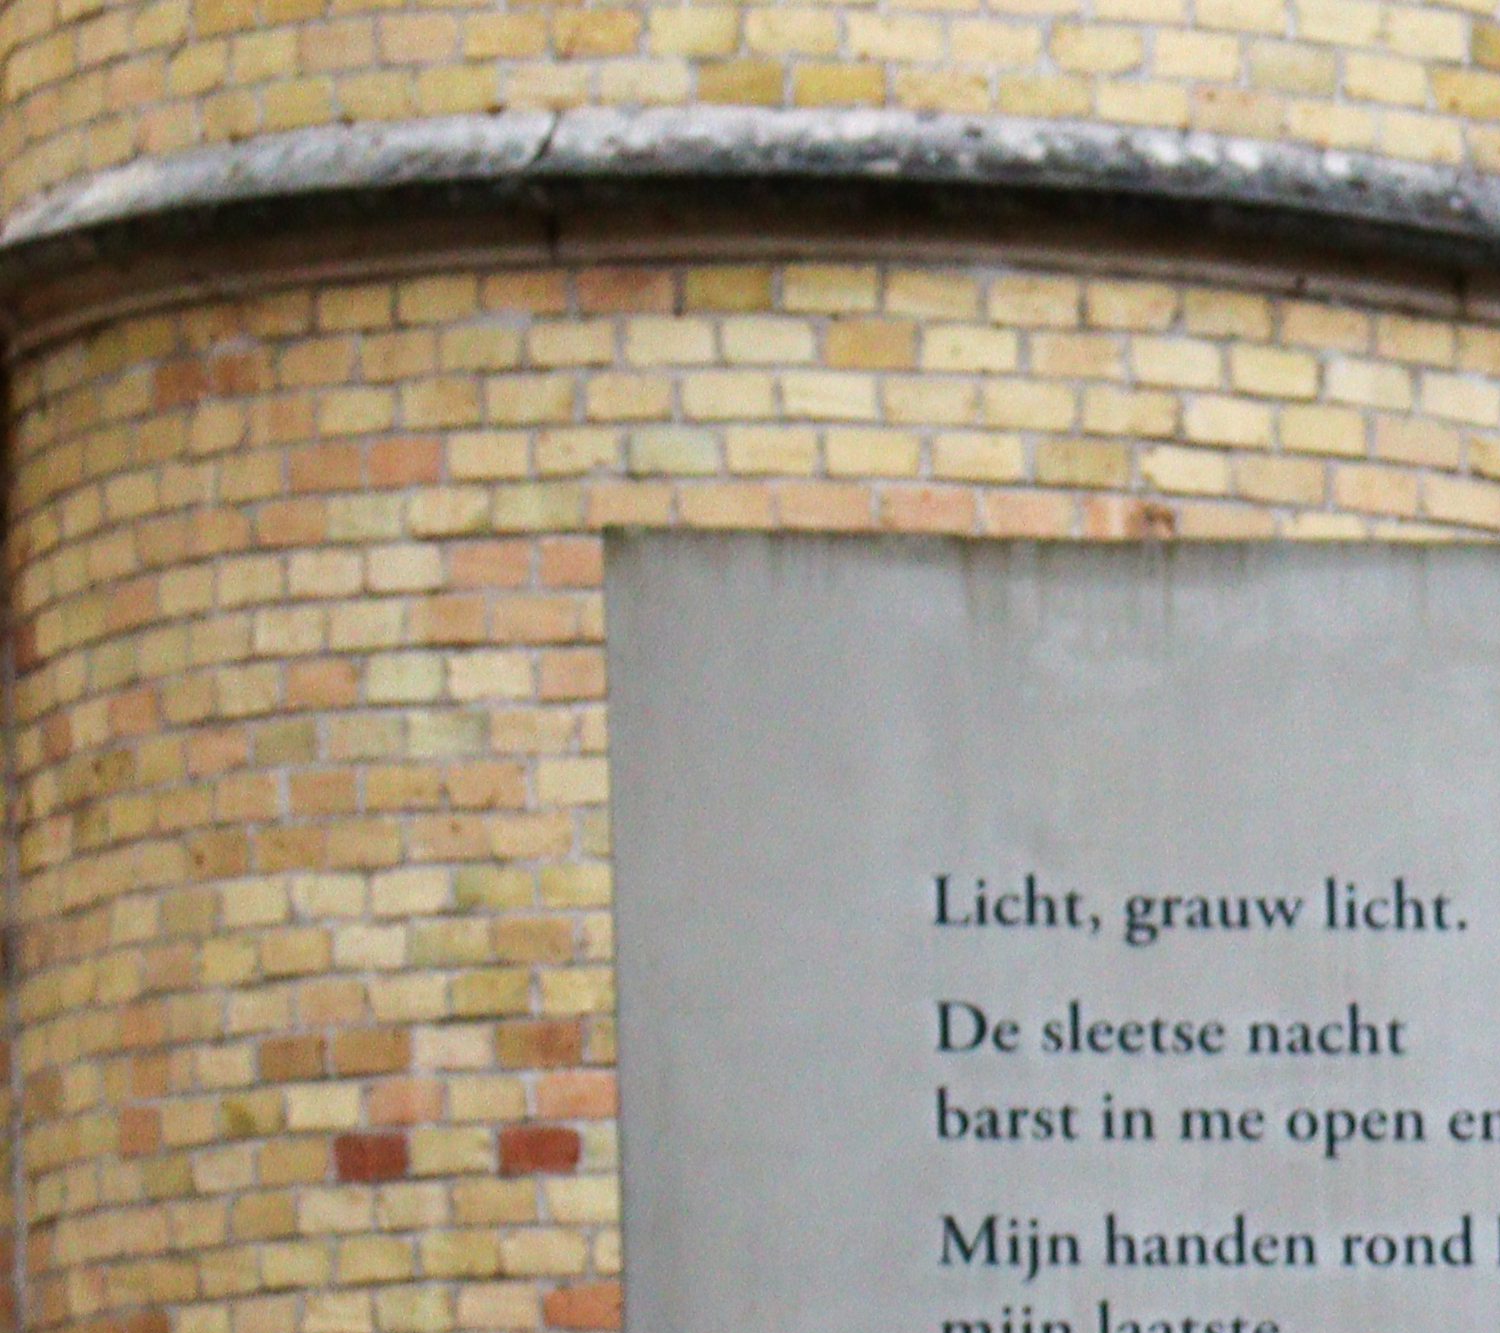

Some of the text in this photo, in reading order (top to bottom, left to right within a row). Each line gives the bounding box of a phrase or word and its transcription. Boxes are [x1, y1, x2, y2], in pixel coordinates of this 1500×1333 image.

[932, 871, 1469, 950] Licht, grauw licht.
[935, 997, 1407, 1059] De sleetse nacht
[934, 1084, 1079, 1144] barst
[1100, 1091, 1158, 1143] in
[1178, 1106, 1267, 1144] me
[1284, 1107, 1428, 1163] open
[938, 1212, 1083, 1284] Mijn
[1103, 1210, 1319, 1269] handen
[1341, 1211, 1476, 1270] rond
